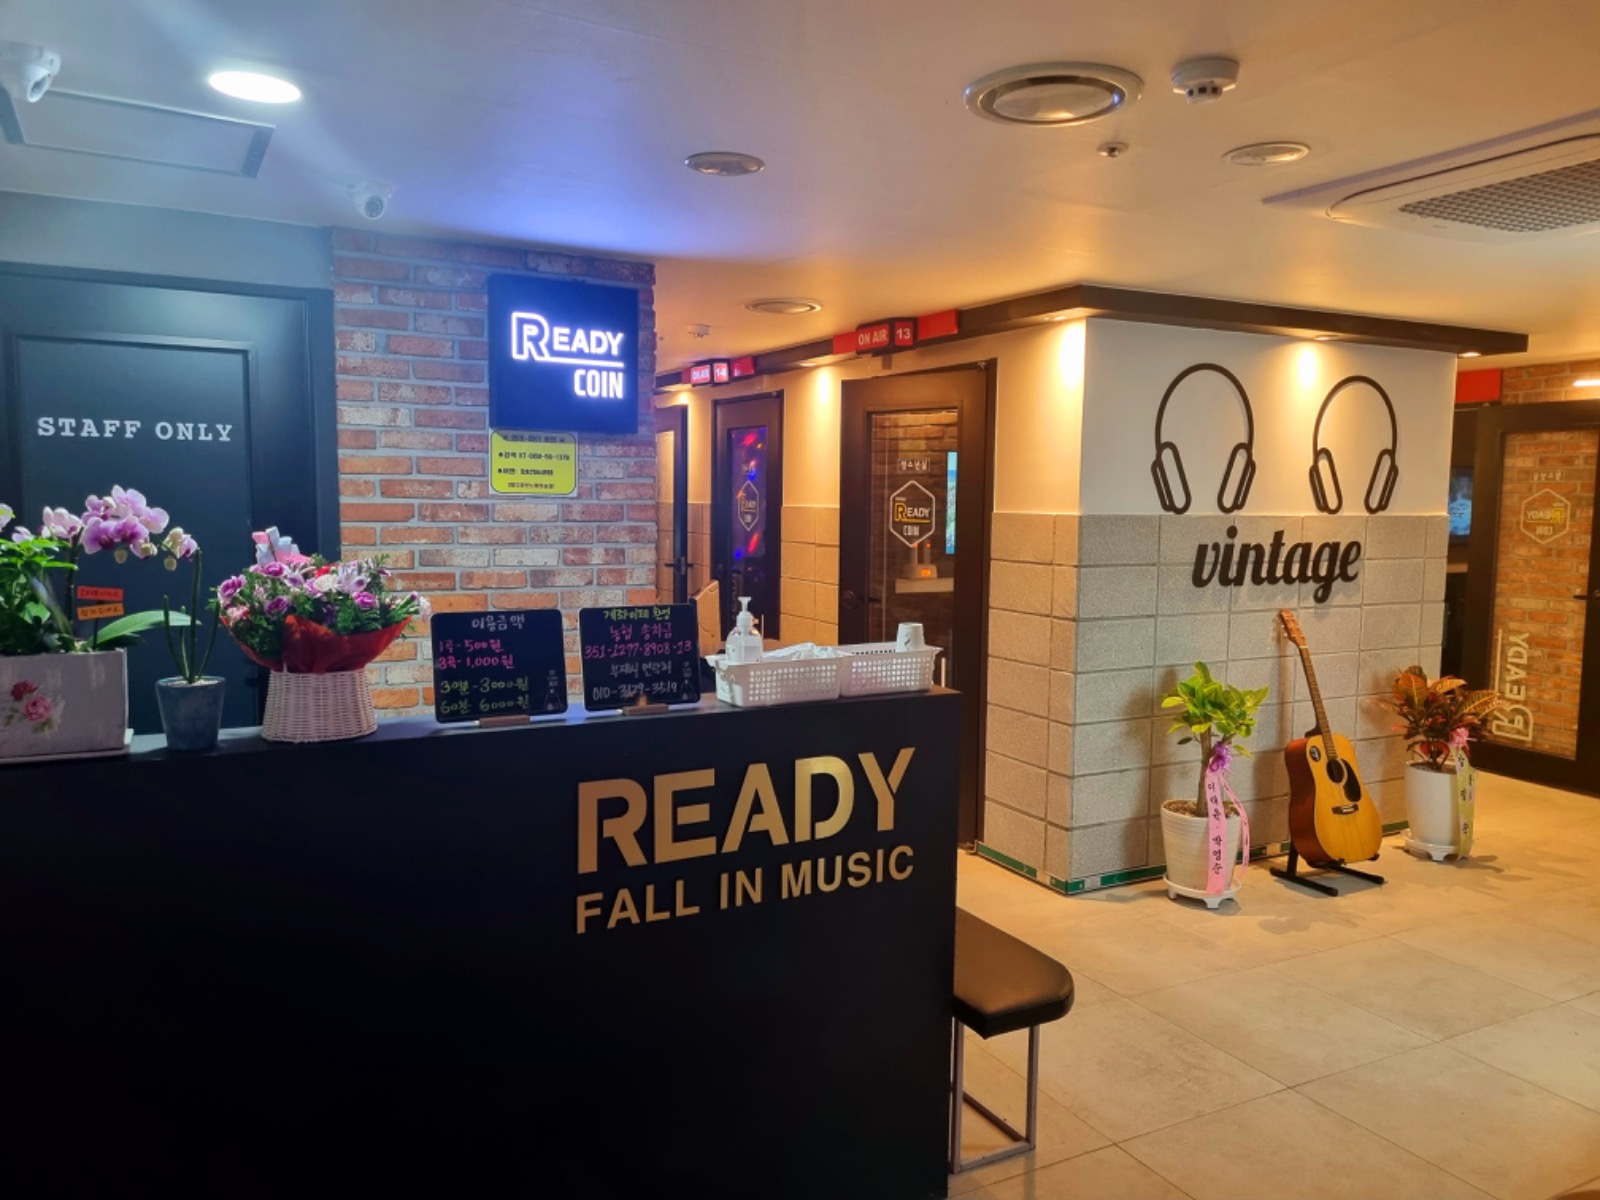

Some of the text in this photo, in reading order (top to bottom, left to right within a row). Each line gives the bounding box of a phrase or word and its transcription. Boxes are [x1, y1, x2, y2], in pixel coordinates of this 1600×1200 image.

[511, 311, 624, 361] READY
[858, 329, 888, 346] ON AIR
[896, 328, 911, 340] 13
[574, 369, 624, 399] COIN
[37, 417, 233, 442] STAFF ONLY
[894, 502, 931, 522] READY
[1192, 524, 1362, 604] vintage
[577, 747, 916, 875] READY
[576, 845, 914, 935] FALL IN MUSIC
